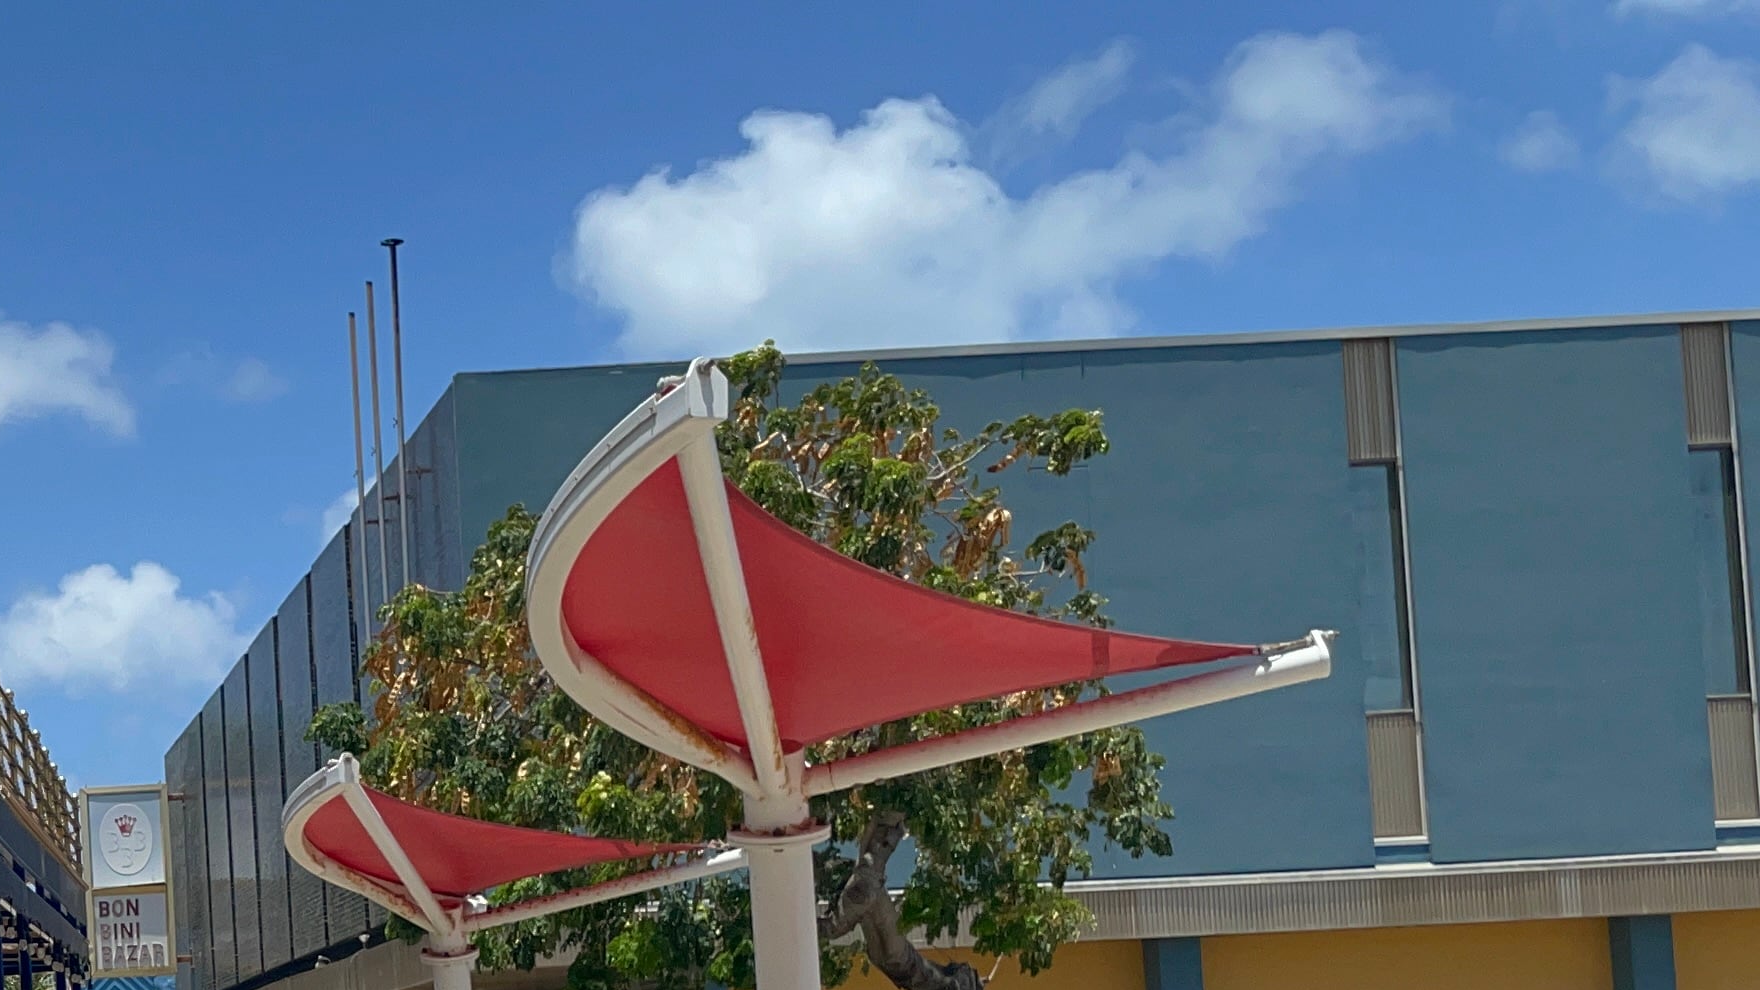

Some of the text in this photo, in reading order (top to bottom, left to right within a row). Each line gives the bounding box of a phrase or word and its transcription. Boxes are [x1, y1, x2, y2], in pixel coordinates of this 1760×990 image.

[99, 898, 140, 918] BON
[100, 922, 140, 940] BINI
[101, 943, 165, 966] BAZAR
